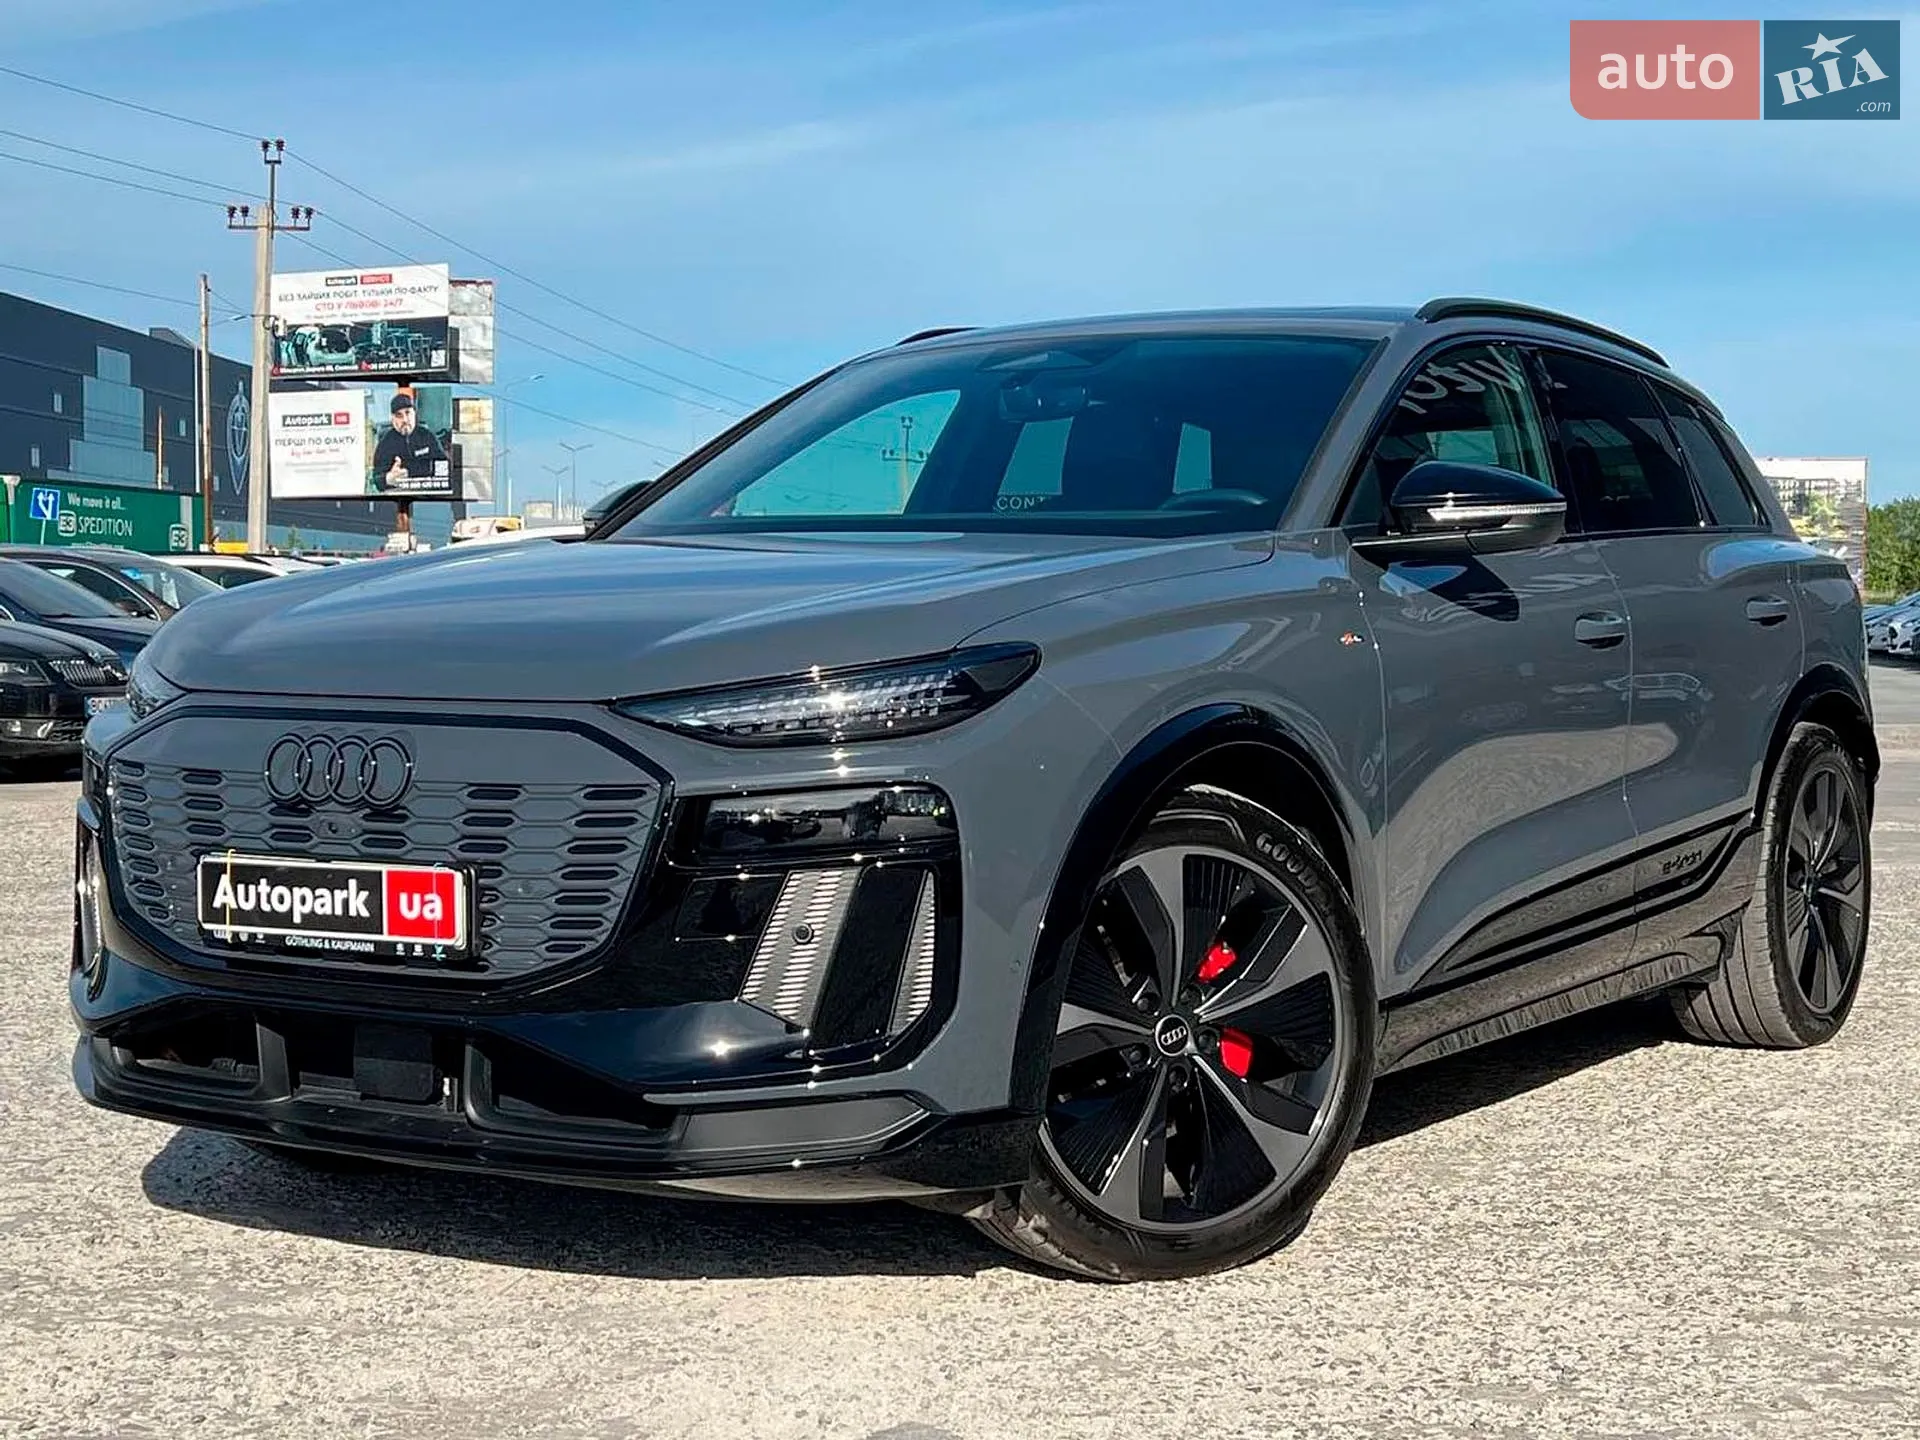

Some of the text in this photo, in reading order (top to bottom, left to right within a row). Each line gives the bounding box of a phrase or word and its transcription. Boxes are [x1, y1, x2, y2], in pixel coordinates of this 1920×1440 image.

[284, 414, 329, 427] Autopark
[308, 437, 322, 446] ПО
[67, 492, 81, 506] We
[82, 496, 103, 509] move
[78, 516, 133, 537] SPEDITION
[212, 874, 443, 924] Autopark ua
